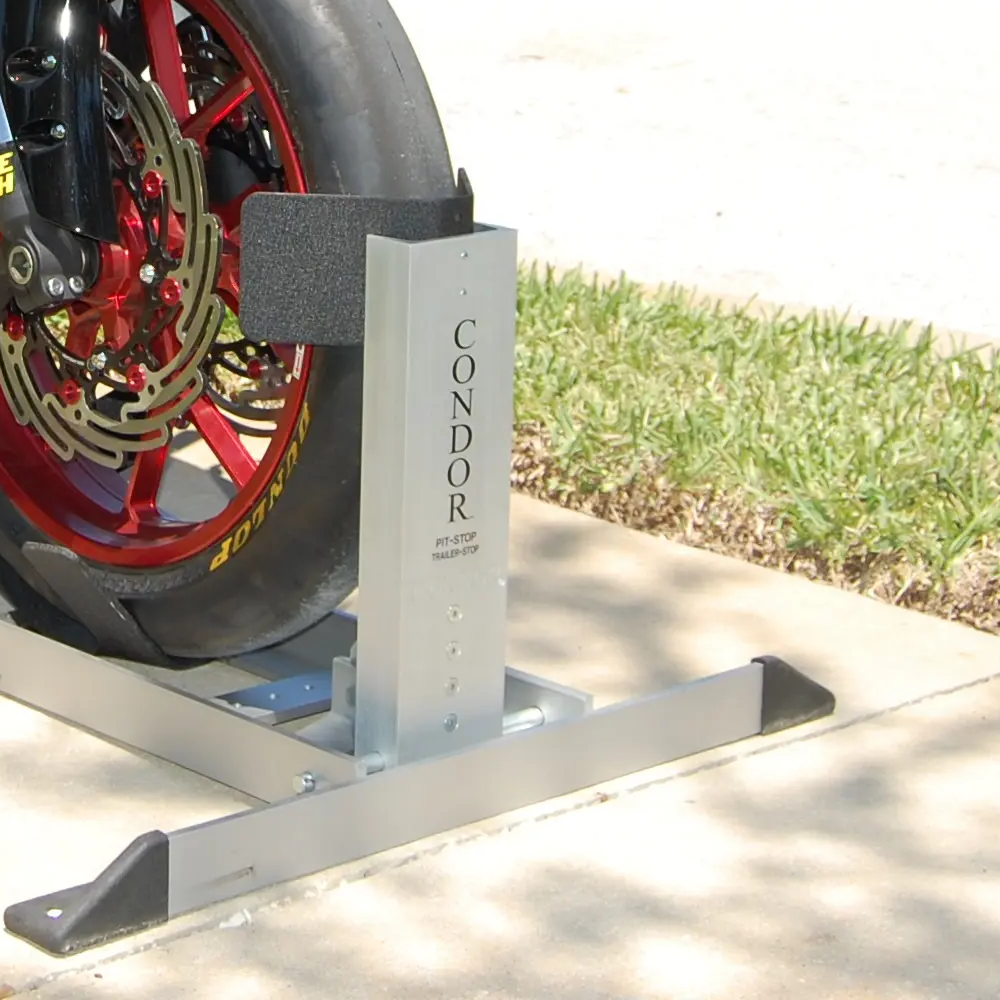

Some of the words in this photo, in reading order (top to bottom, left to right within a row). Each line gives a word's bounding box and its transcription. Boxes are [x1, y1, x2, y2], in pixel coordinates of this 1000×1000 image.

[447, 319, 477, 523] CONDOR
[209, 402, 311, 572] DUNLOP
[431, 544, 480, 561] TRAILER-STOP
[435, 531, 477, 548] PIT-STOP
